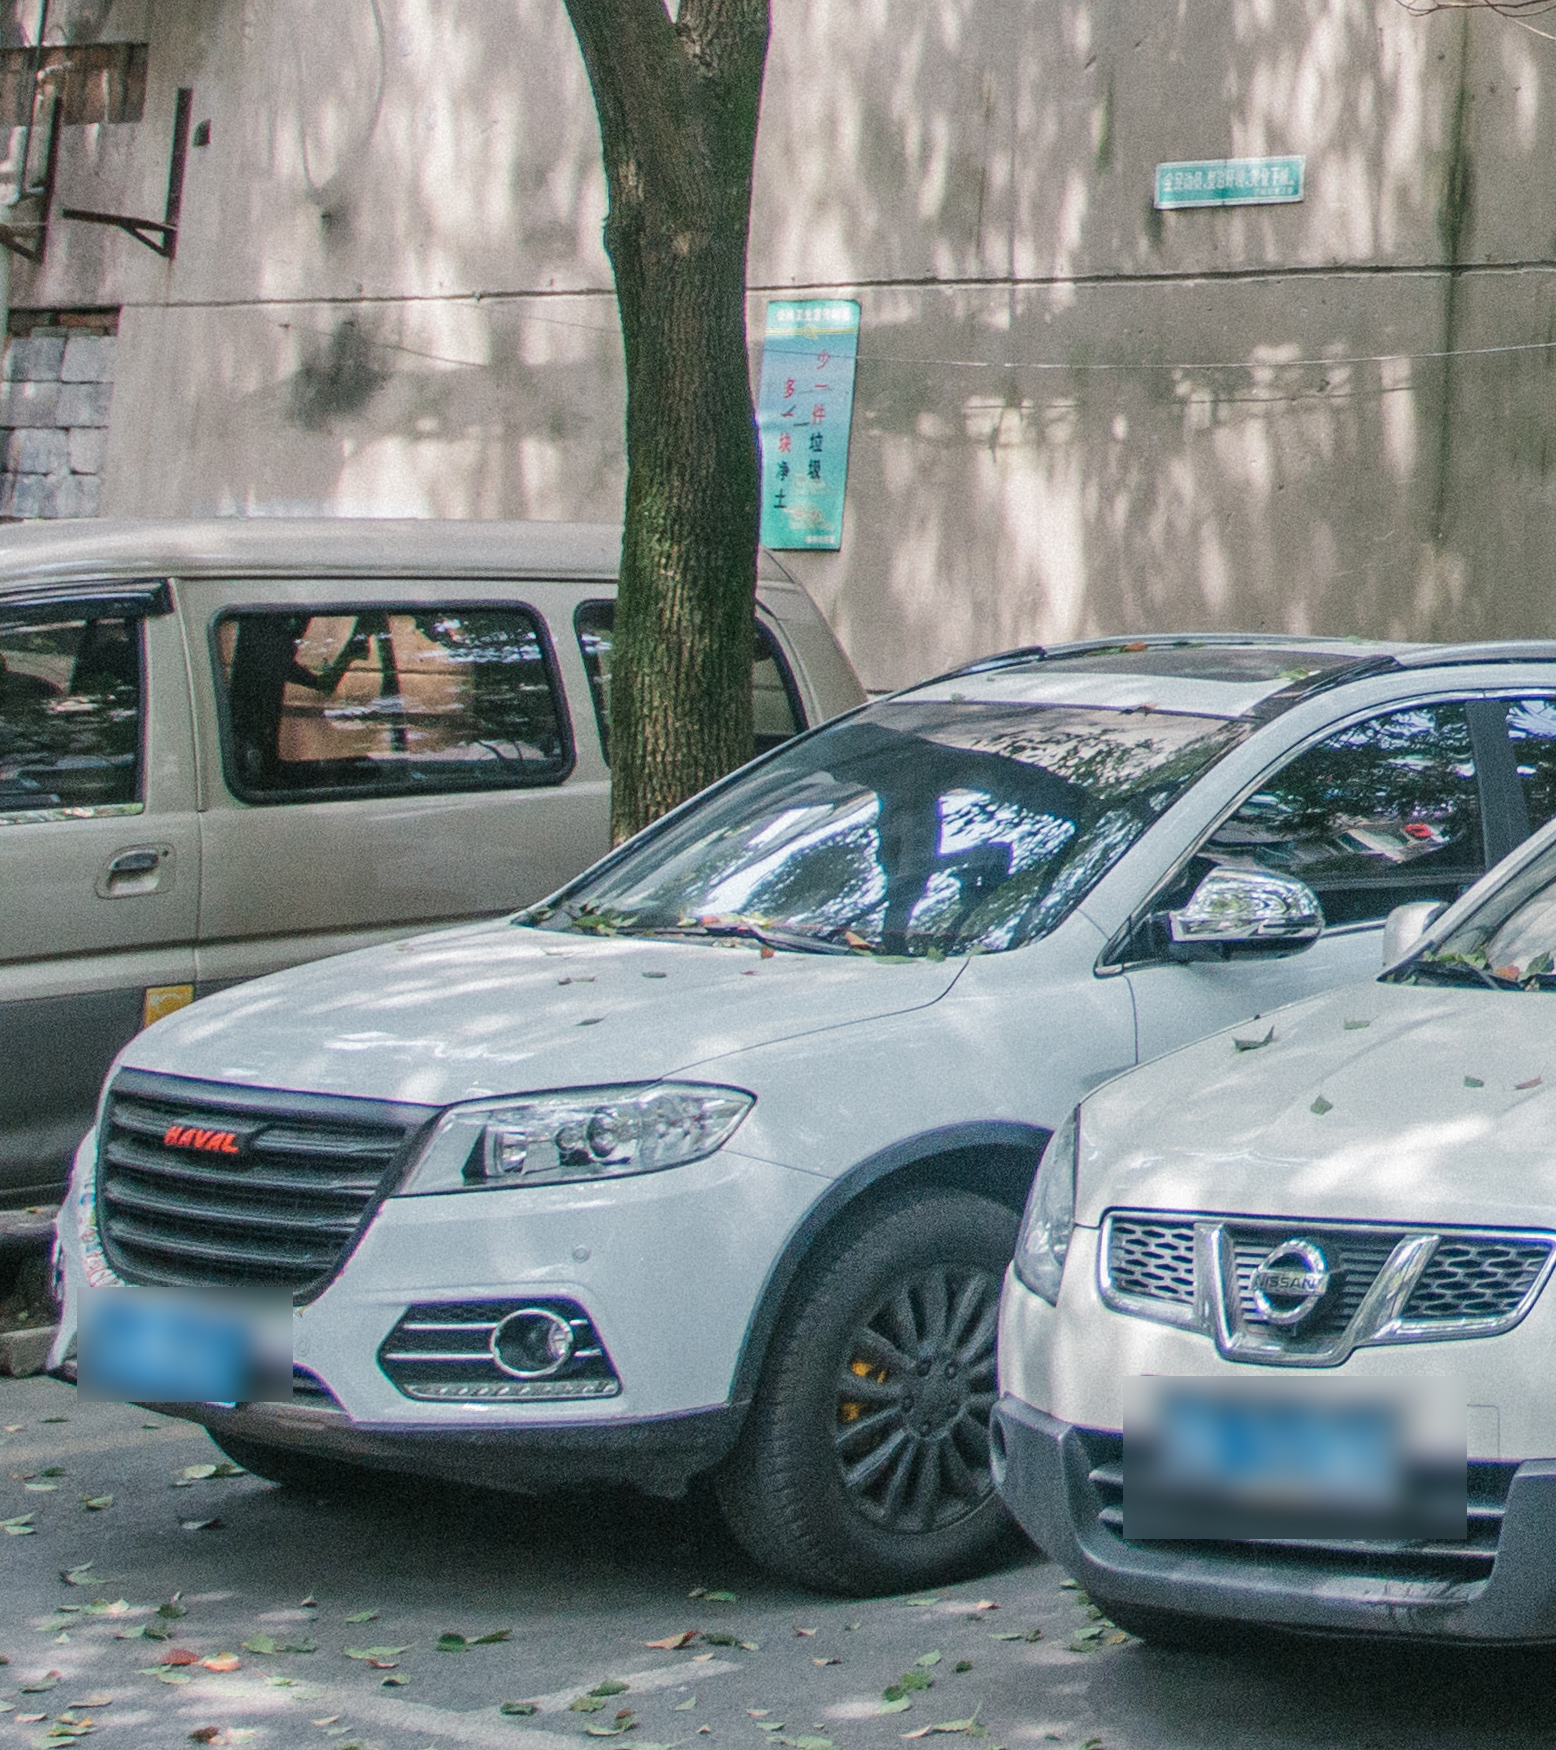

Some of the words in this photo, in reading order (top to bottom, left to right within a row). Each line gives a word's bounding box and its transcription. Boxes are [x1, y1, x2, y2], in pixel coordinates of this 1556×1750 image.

[773, 378, 797, 509] 多一块净土
[807, 349, 831, 480] 少一件垃圾
[163, 1126, 239, 1154] HAVAL
[1257, 1274, 1318, 1290] NISSAN
